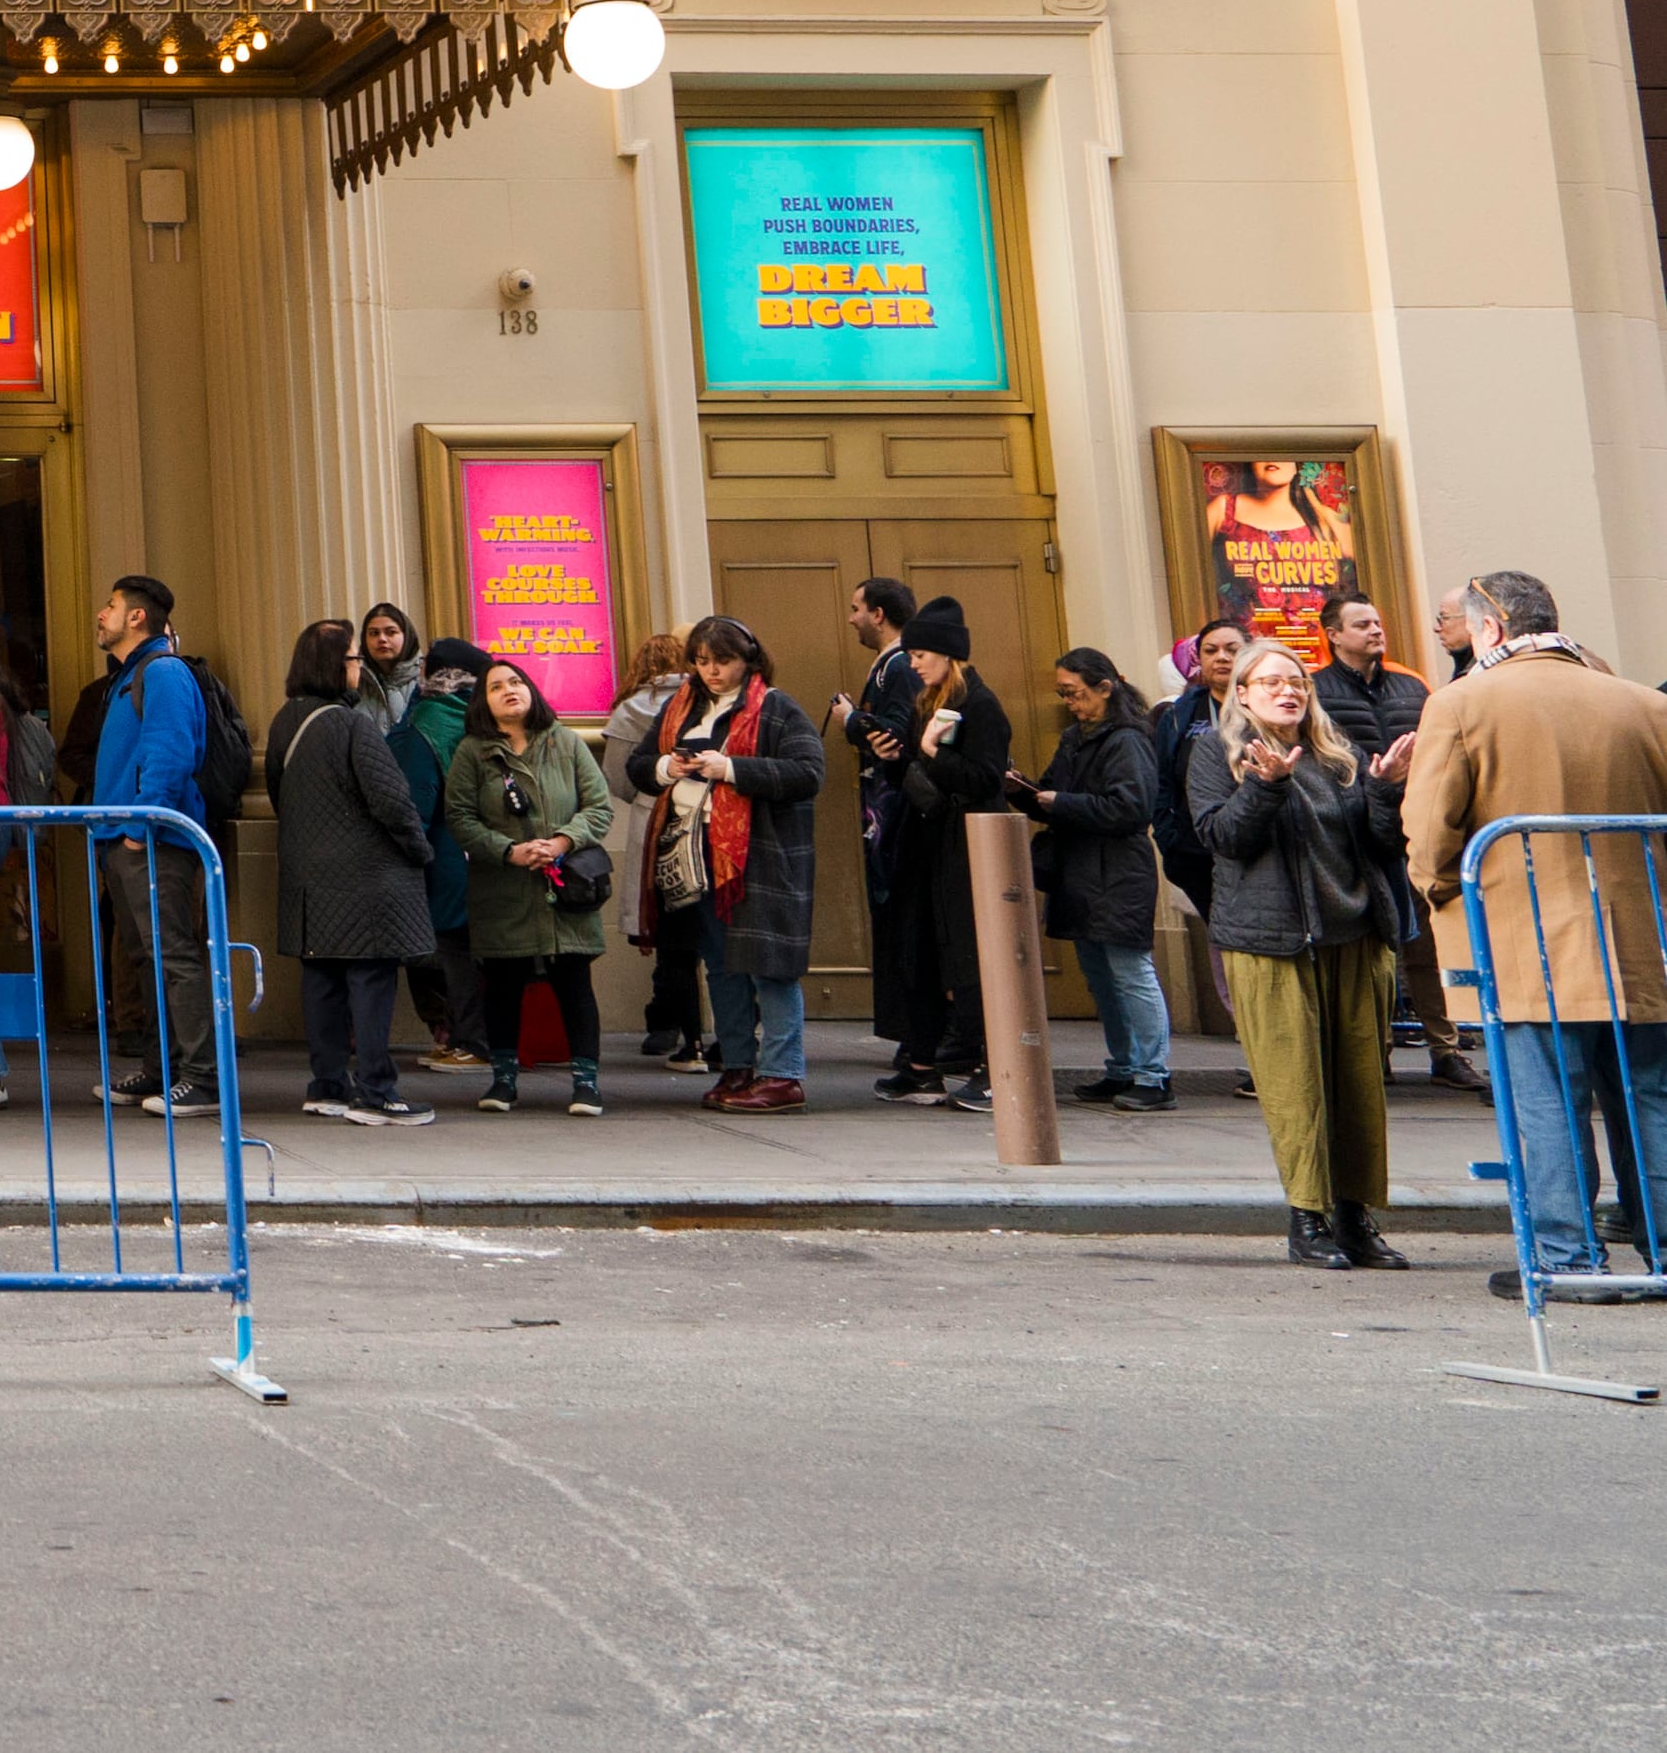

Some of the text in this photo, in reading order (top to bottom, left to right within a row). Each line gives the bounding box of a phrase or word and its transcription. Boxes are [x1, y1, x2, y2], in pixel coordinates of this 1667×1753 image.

[781, 197, 894, 211] REAL WOMEN
[763, 219, 920, 234] PUSH BOUNDARIES,
[783, 241, 905, 256] EMBRACE LIFE,
[757, 264, 929, 294] DREAM
[757, 298, 938, 328] BIGGER
[499, 310, 538, 336] 138
[1225, 541, 1342, 560] REAL WOMEN
[507, 564, 566, 578] LOVE
[1256, 561, 1337, 585] CURVES
[486, 577, 593, 591] COURSES
[498, 627, 586, 641] WE CAN
[487, 640, 530, 655] ALL
